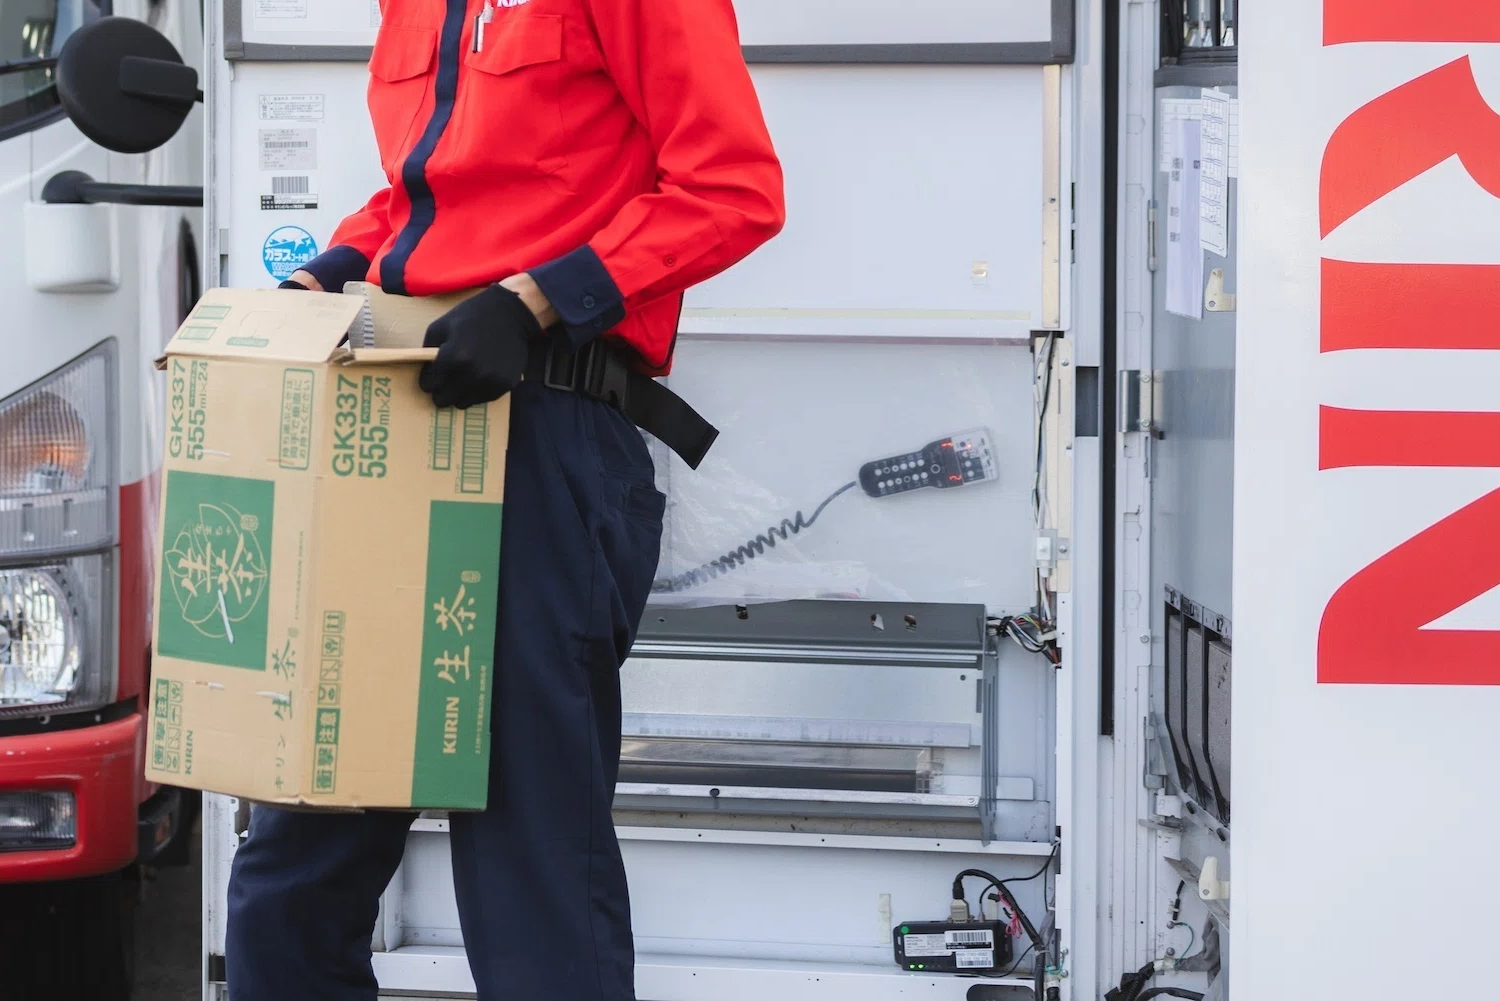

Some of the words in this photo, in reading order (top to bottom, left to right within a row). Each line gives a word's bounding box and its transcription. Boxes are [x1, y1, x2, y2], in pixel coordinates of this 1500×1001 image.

[169, 359, 186, 459] GK337
[299, 380, 310, 460] お持ちください
[332, 373, 358, 477] GK337
[177, 532, 254, 605] 生茶
[433, 583, 477, 685] 生茶
[272, 639, 297, 722] 生茶
[184, 729, 194, 776] KIRIN
[274, 734, 286, 791] キリン
[315, 711, 337, 790] 衝撃注意
[443, 696, 460, 755] KIRIN
